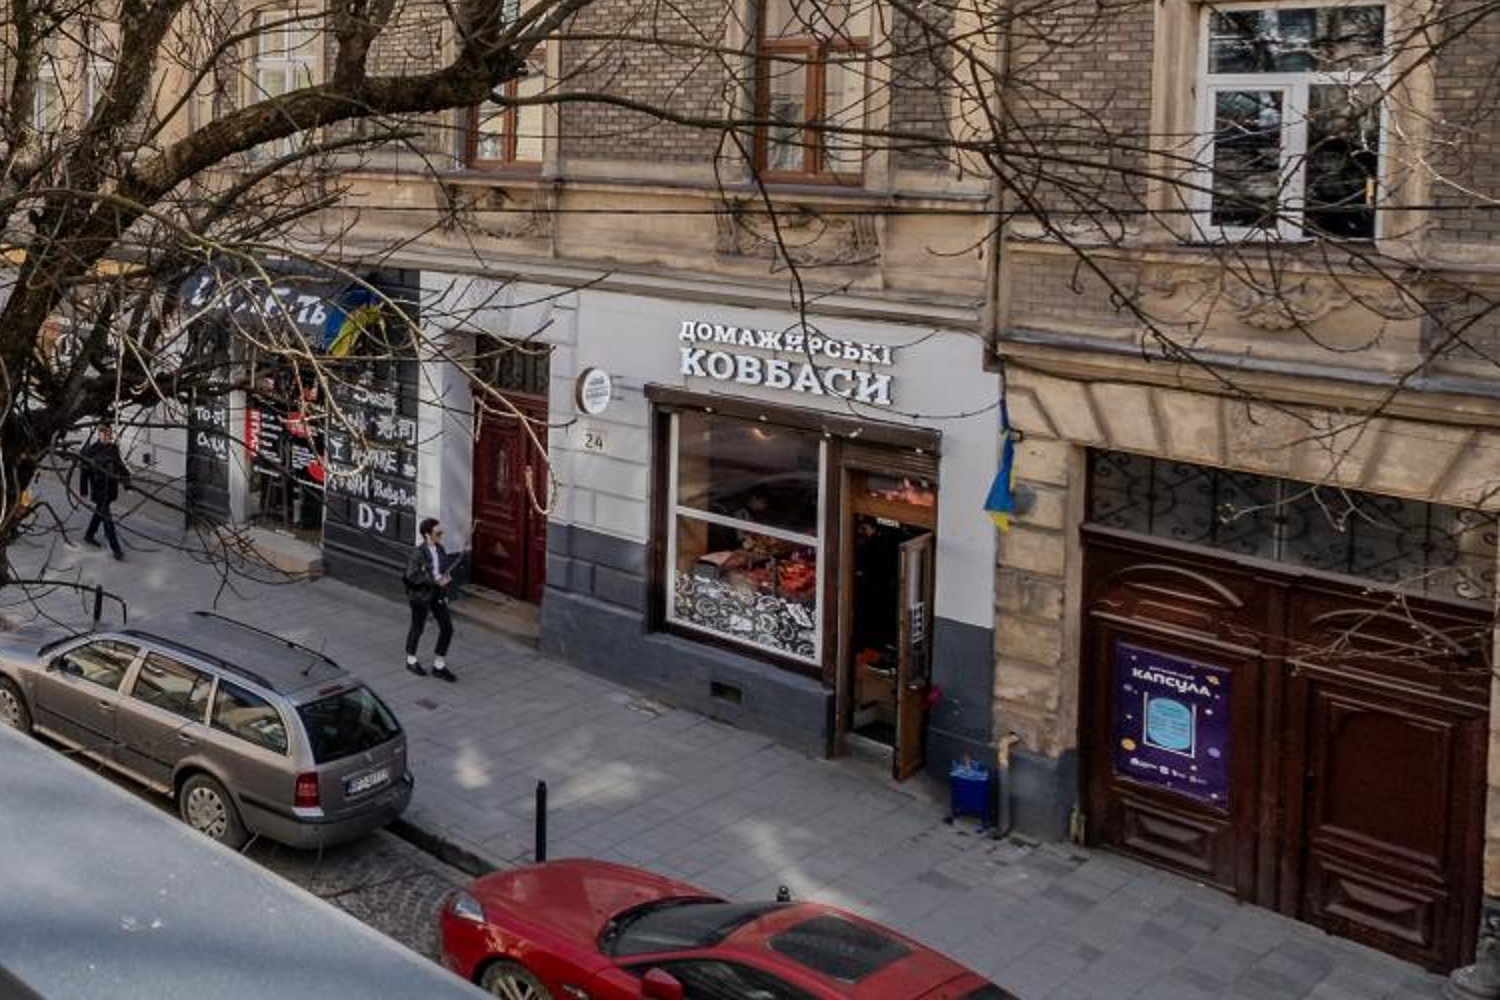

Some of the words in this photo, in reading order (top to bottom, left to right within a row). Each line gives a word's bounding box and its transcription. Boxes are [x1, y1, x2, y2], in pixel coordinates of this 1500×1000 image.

[678, 320, 894, 365] ДОМАЖИРСЬКІ
[679, 347, 893, 405] КОВБАСИ
[357, 503, 391, 533] DJ
